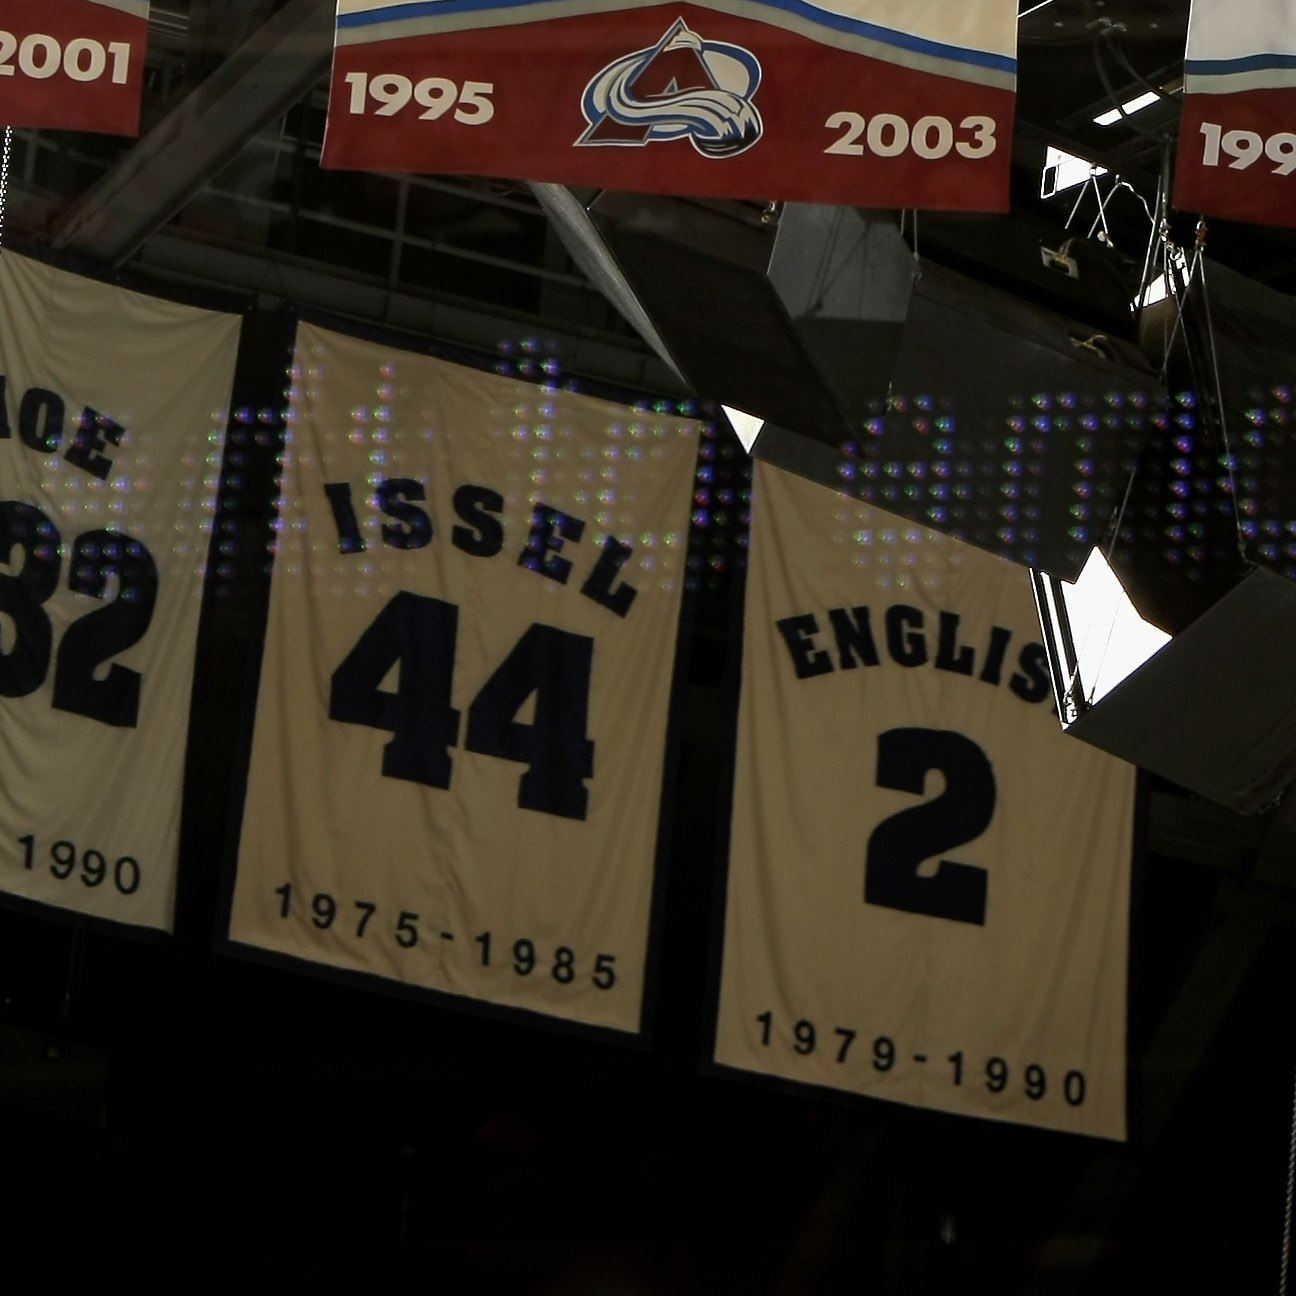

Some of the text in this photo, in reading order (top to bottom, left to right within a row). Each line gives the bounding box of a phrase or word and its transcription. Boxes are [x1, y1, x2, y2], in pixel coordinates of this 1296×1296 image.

[344, 72, 495, 126] 1995
[823, 111, 998, 160] 2003
[324, 477, 638, 618] ISSEL
[328, 590, 595, 821] 44
[776, 604, 1059, 716] ENGLIS
[864, 726, 997, 926] 2
[274, 882, 617, 990] 1975-1985
[756, 1011, 1086, 1106] 1979-1990
